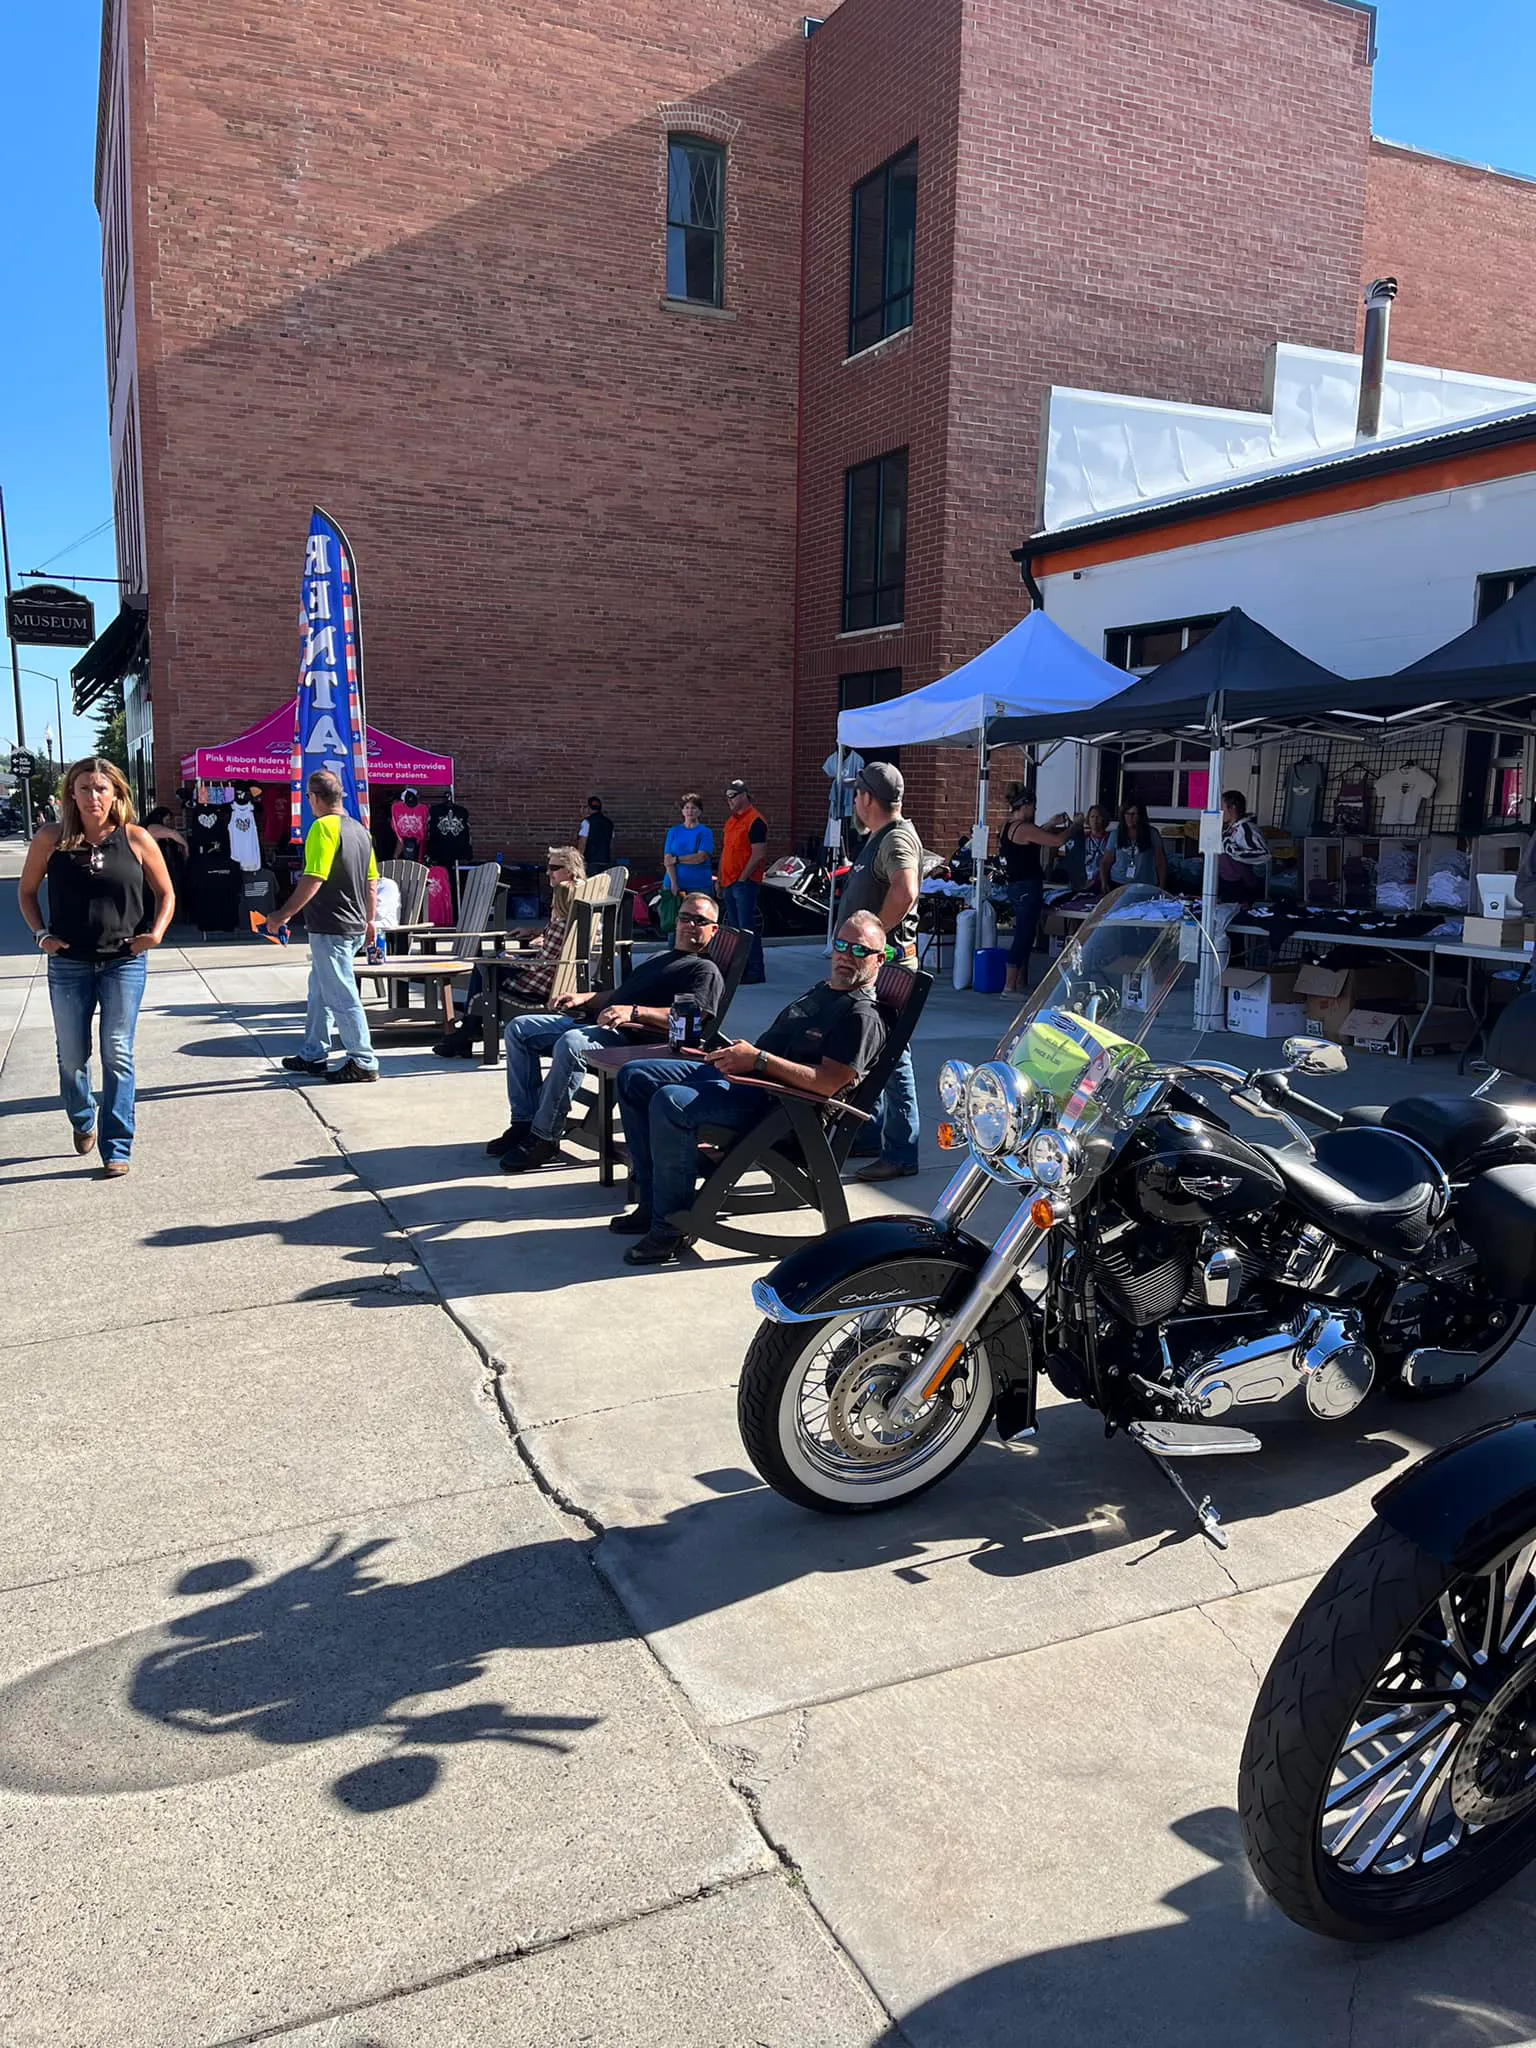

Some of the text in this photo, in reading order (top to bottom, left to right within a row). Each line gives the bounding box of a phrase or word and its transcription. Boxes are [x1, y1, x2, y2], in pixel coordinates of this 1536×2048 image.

[13, 613, 88, 630] MUSEUM
[205, 753, 224, 762] Pink
[226, 755, 256, 764] Ribbon
[258, 756, 285, 764] Riders
[224, 764, 249, 773] direct
[251, 765, 285, 774] financial
[395, 761, 411, 769] that
[413, 762, 446, 770] provides
[838, 1287, 912, 1304] Deluxe
